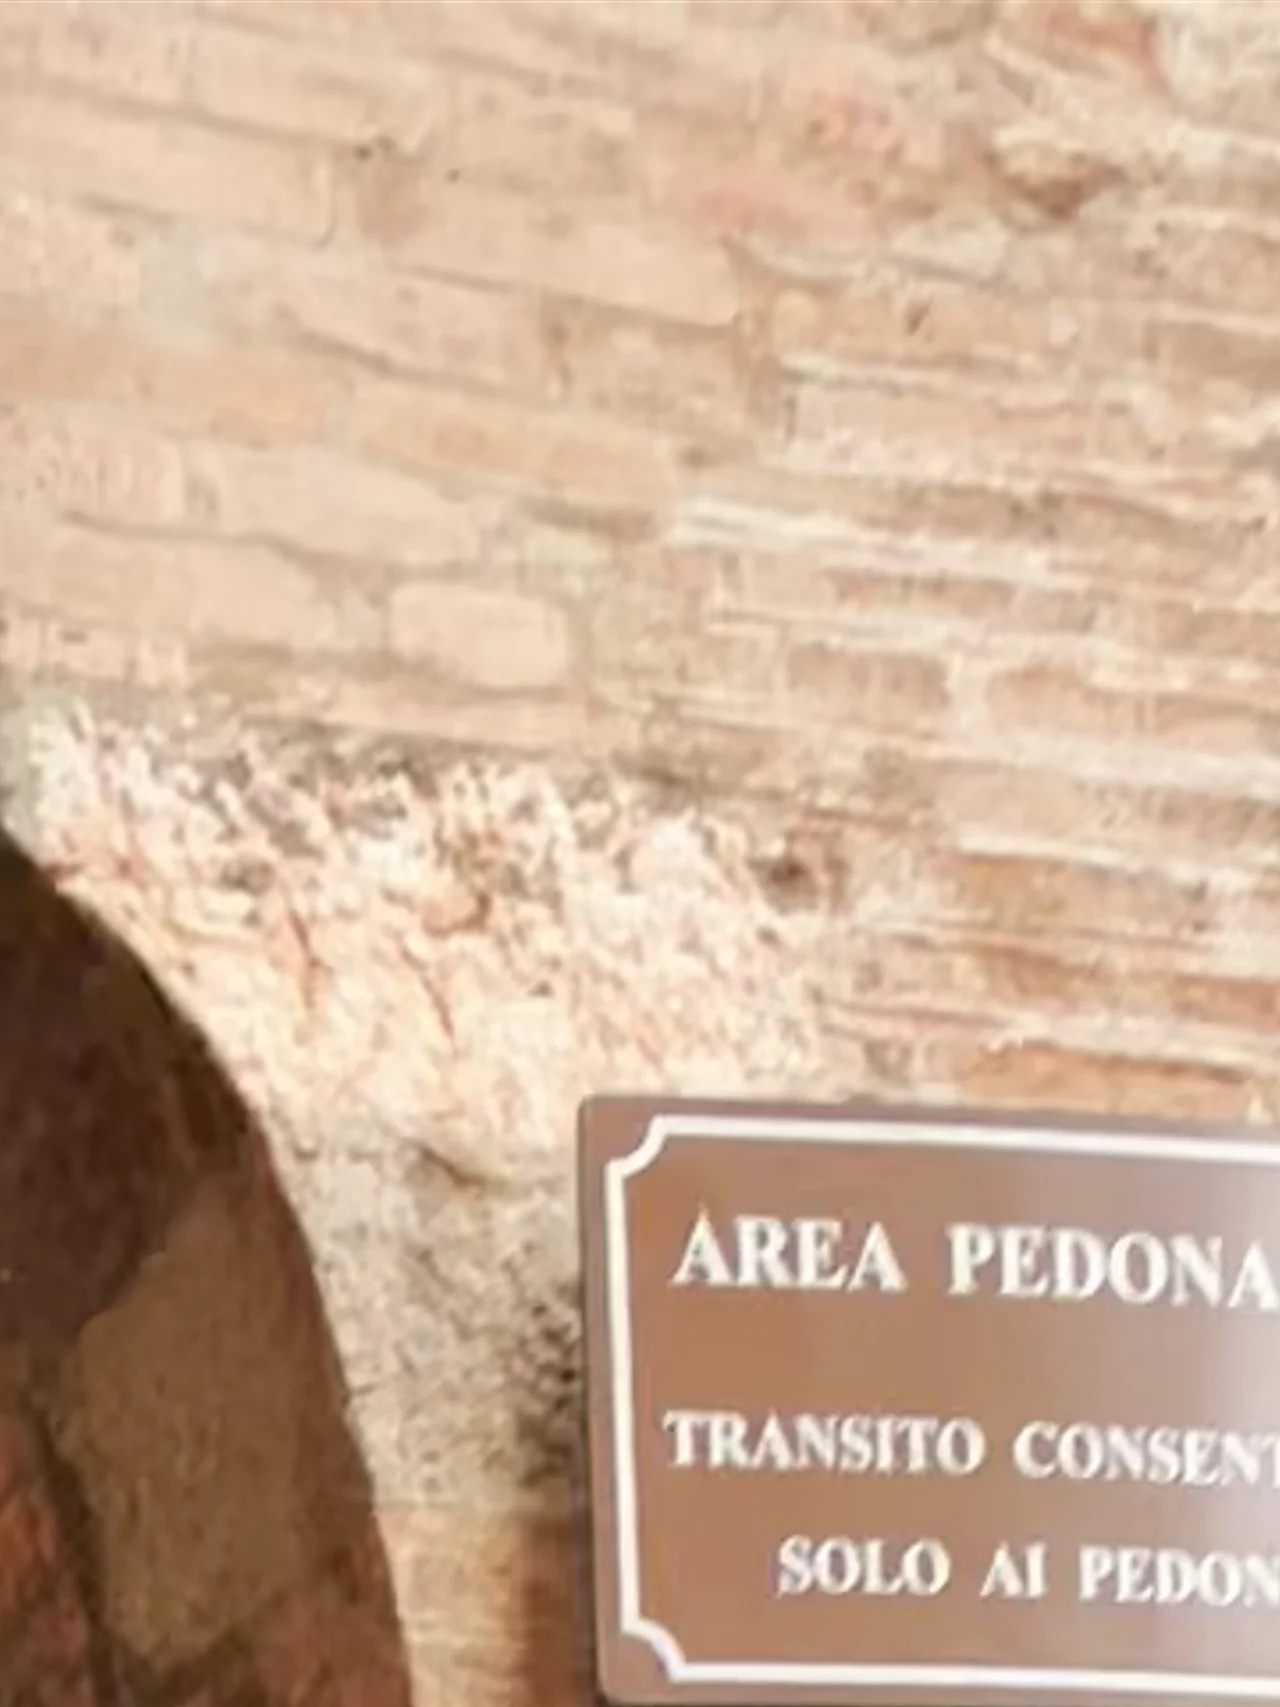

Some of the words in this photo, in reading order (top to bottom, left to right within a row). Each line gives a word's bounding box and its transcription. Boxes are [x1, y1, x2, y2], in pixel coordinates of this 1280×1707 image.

[670, 1206, 907, 1293] AREA
[663, 1410, 985, 1476] TRANSITO
[778, 1534, 950, 1598] SOLO
[980, 1541, 1047, 1599] AI
